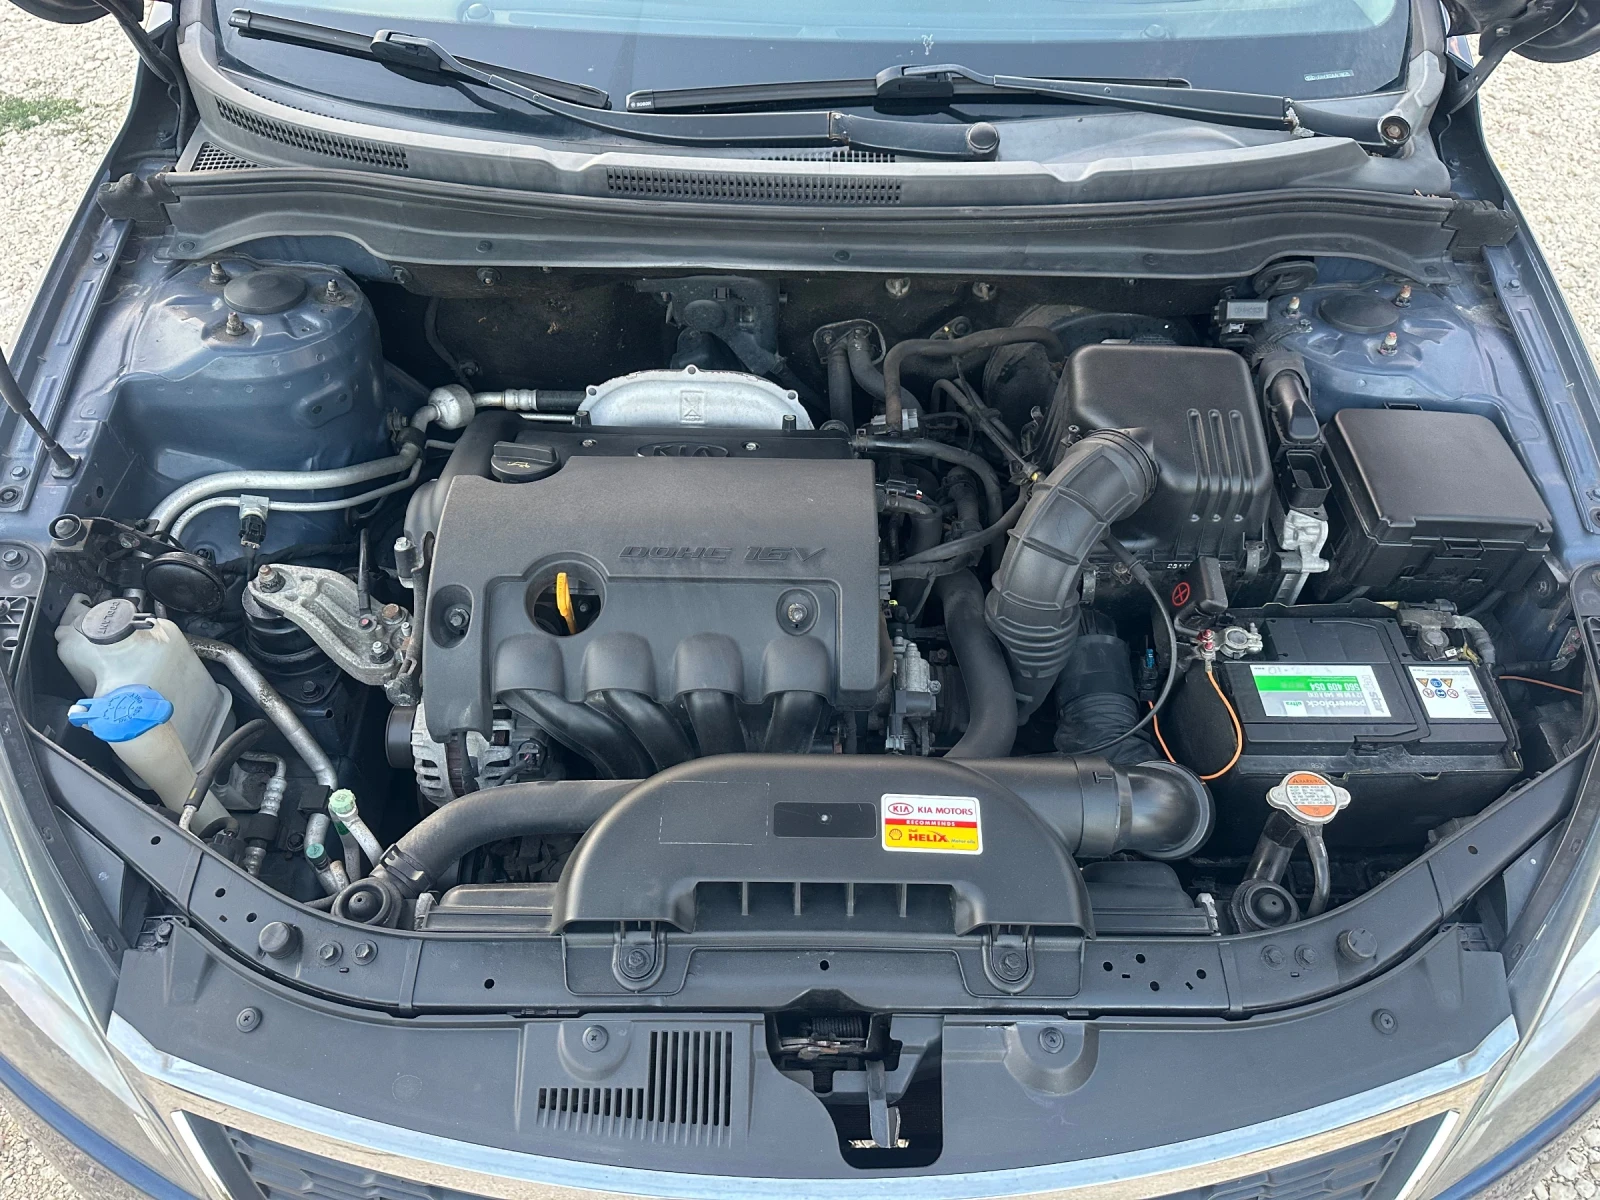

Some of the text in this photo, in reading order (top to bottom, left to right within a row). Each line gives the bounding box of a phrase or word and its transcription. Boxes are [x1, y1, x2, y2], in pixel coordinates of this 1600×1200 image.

[653, 444, 711, 457] KIA
[619, 545, 826, 562] DOHC 16V
[97, 601, 121, 634] COOLANT
[1309, 682, 1326, 691] 054
[1327, 682, 1343, 691] 409
[1343, 682, 1360, 691] 560
[1306, 699, 1367, 708] powerblock
[892, 805, 911, 813] KIA
[917, 806, 973, 815] KIA MOTORS
[908, 832, 949, 843] HELIX
